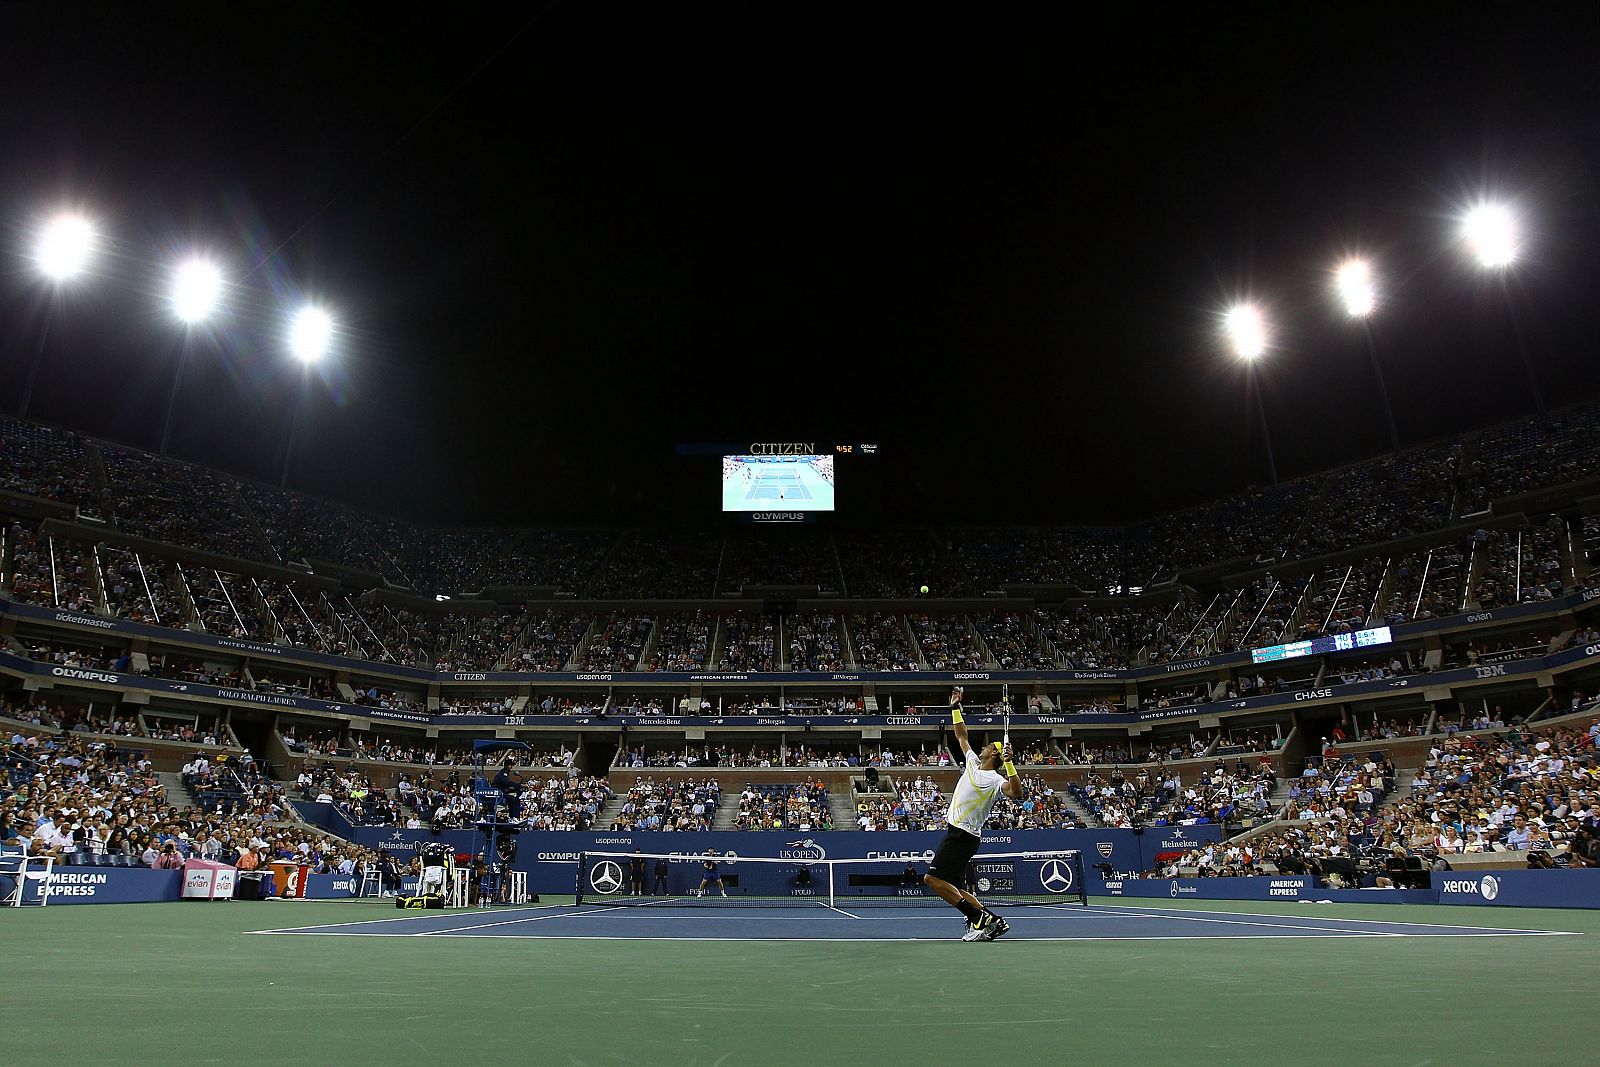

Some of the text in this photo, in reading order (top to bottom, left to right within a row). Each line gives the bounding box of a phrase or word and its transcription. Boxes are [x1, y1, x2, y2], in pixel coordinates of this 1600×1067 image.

[750, 443, 815, 455] CITIZEN
[752, 512, 804, 520] OLYMPUS
[55, 612, 115, 628] ticketmaster
[1467, 612, 1492, 622] evian
[218, 639, 281, 654] UNITED AIRLINES
[1166, 661, 1192, 672] TIFFANY
[1475, 665, 1506, 678] IBM
[52, 667, 118, 683] OLYMPUS
[454, 673, 486, 681] CITIZEN
[576, 674, 612, 682] usopen.org
[218, 690, 297, 706] POLO RALPH LAUREN
[1294, 688, 1332, 700] CHASE
[370, 710, 430, 722] AMERICAN EXPRESS
[1166, 708, 1197, 716] AIRLINES
[504, 717, 525, 726] IBM
[886, 717, 921, 725] CITIZEN
[1038, 715, 1065, 724] WESTIN
[378, 841, 415, 850] Heineken
[595, 837, 632, 847] usopen.org
[1161, 839, 1198, 849] Heineken
[779, 849, 819, 859] US OPEN
[867, 851, 920, 863] CHASE
[976, 864, 1013, 873] CITIZEN
[187, 880, 208, 888] evian
[216, 882, 232, 891] evian
[332, 881, 349, 890] xerox
[1270, 880, 1304, 889] AMERICAN
[1443, 880, 1478, 893] xerox
[37, 885, 96, 896] EXPRESS
[1270, 888, 1298, 896] EXPRESS
